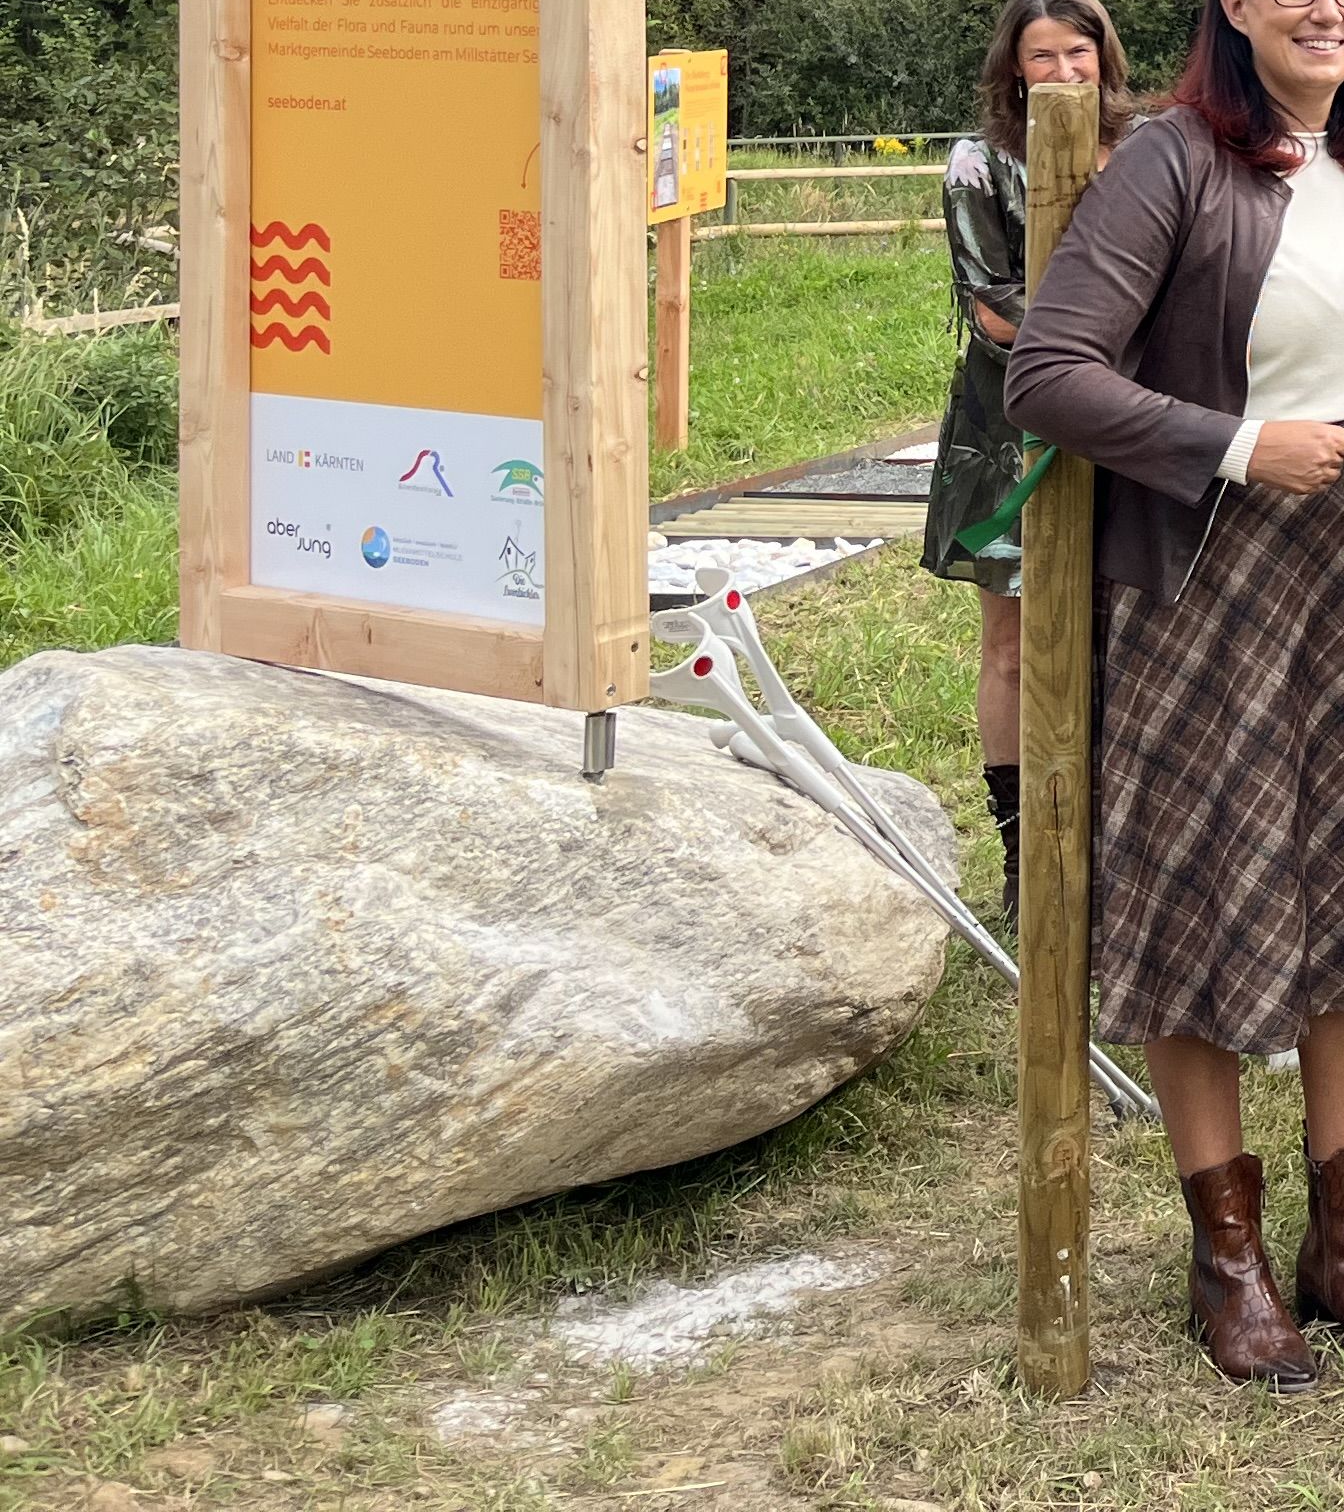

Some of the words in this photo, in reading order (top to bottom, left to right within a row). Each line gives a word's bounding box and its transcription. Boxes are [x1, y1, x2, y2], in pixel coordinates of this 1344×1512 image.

[268, 16, 309, 31] Vielfalt
[312, 17, 333, 32] der
[337, 18, 367, 33] Flora
[371, 19, 396, 33] und
[400, 20, 439, 34] Fauna
[443, 22, 473, 36] rund
[479, 25, 499, 37] um
[267, 42, 366, 60] Marktgemeinde
[367, 46, 432, 60] Seeboden
[433, 50, 453, 61] am
[522, 50, 538, 64] Se
[268, 95, 347, 111] seeboden.at
[266, 449, 294, 464] LAND
[315, 452, 364, 472] KÄRNTEN
[267, 517, 301, 539] aber
[297, 538, 332, 560] jung
